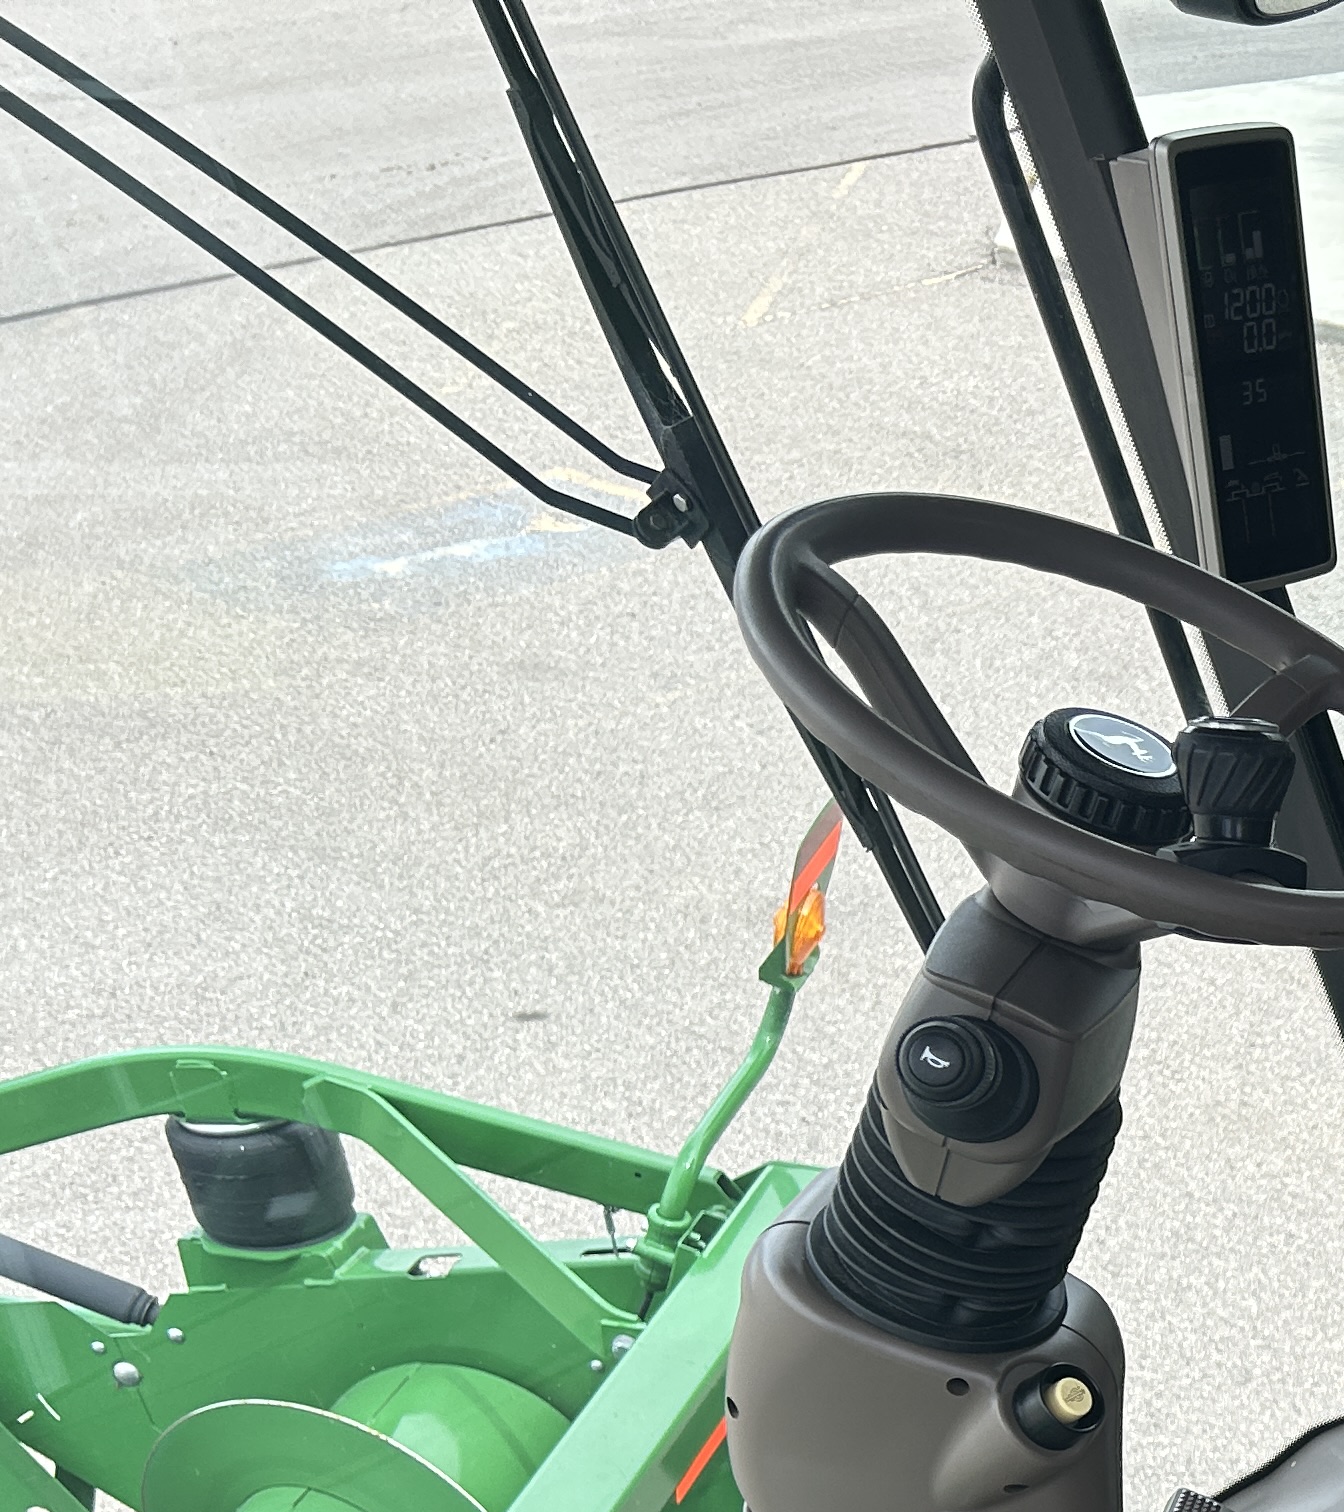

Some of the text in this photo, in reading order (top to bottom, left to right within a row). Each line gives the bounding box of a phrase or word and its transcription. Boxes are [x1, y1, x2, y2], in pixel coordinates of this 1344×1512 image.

[1223, 283, 1276, 320] 1200
[1243, 318, 1277, 354] 0.0
[1241, 379, 1268, 406] 35
